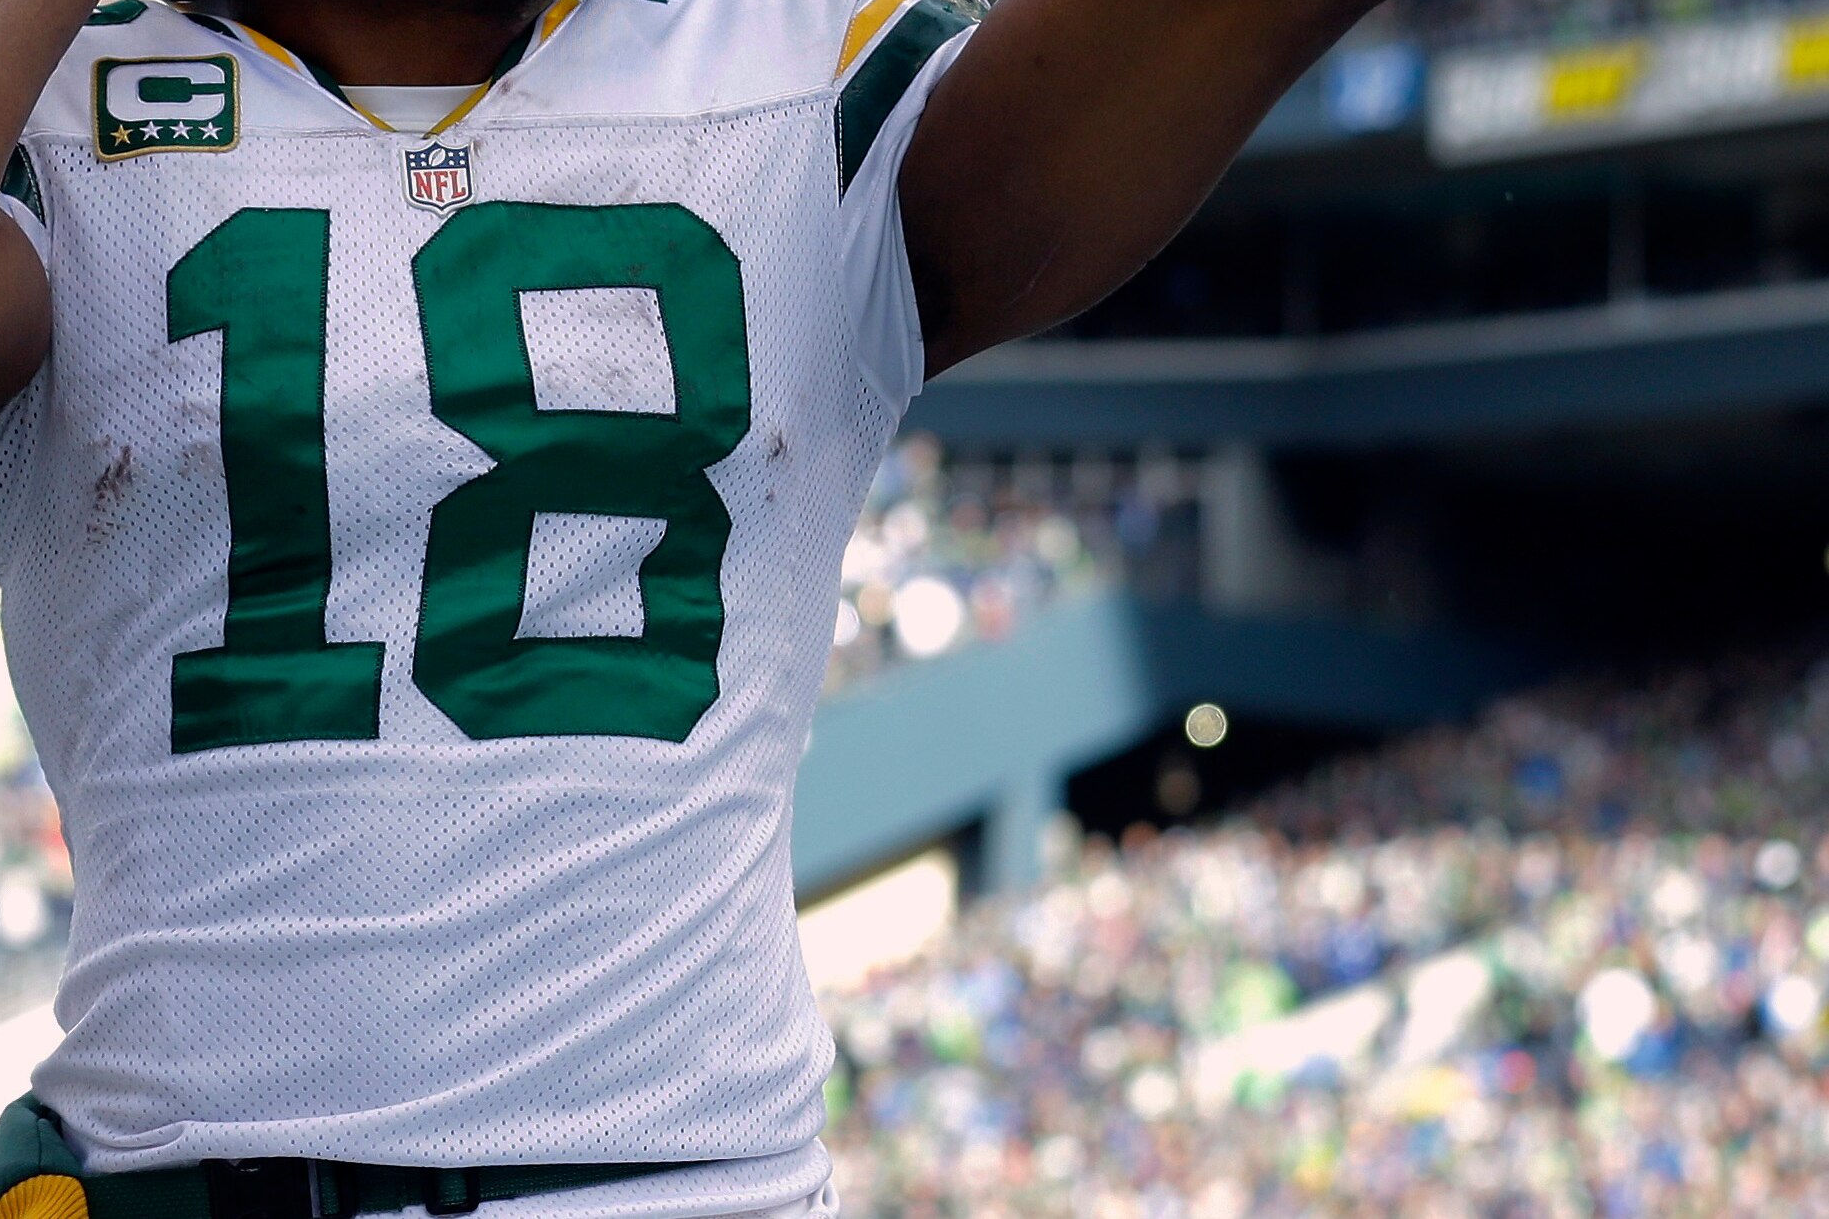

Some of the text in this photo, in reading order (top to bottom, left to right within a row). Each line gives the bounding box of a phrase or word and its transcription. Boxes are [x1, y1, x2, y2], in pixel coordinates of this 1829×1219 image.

[105, 61, 226, 122] C
[412, 167, 467, 203] NFL
[166, 200, 751, 754] 18
